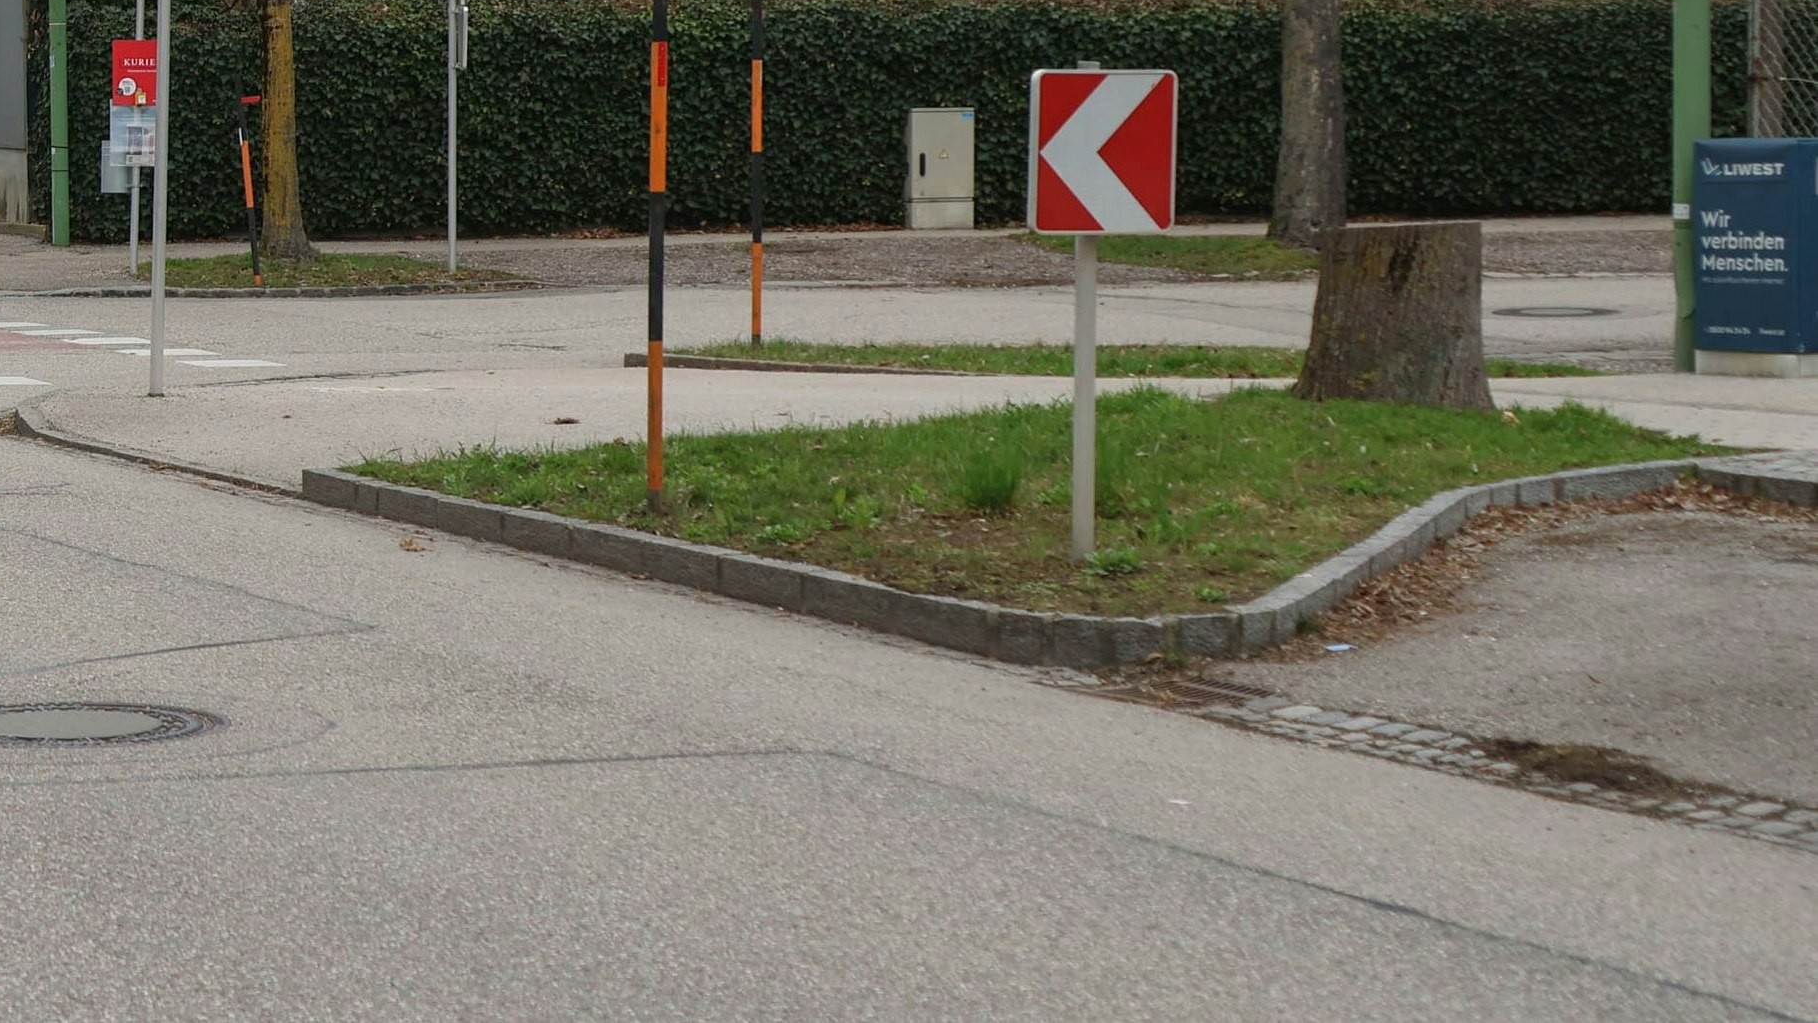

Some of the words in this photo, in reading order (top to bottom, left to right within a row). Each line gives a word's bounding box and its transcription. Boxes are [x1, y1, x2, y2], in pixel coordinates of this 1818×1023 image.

[1723, 163, 1785, 176] LIWEST
[1701, 210, 1731, 228] Wir
[1701, 232, 1785, 250] verbinden
[1702, 253, 1788, 272] Menschen.
